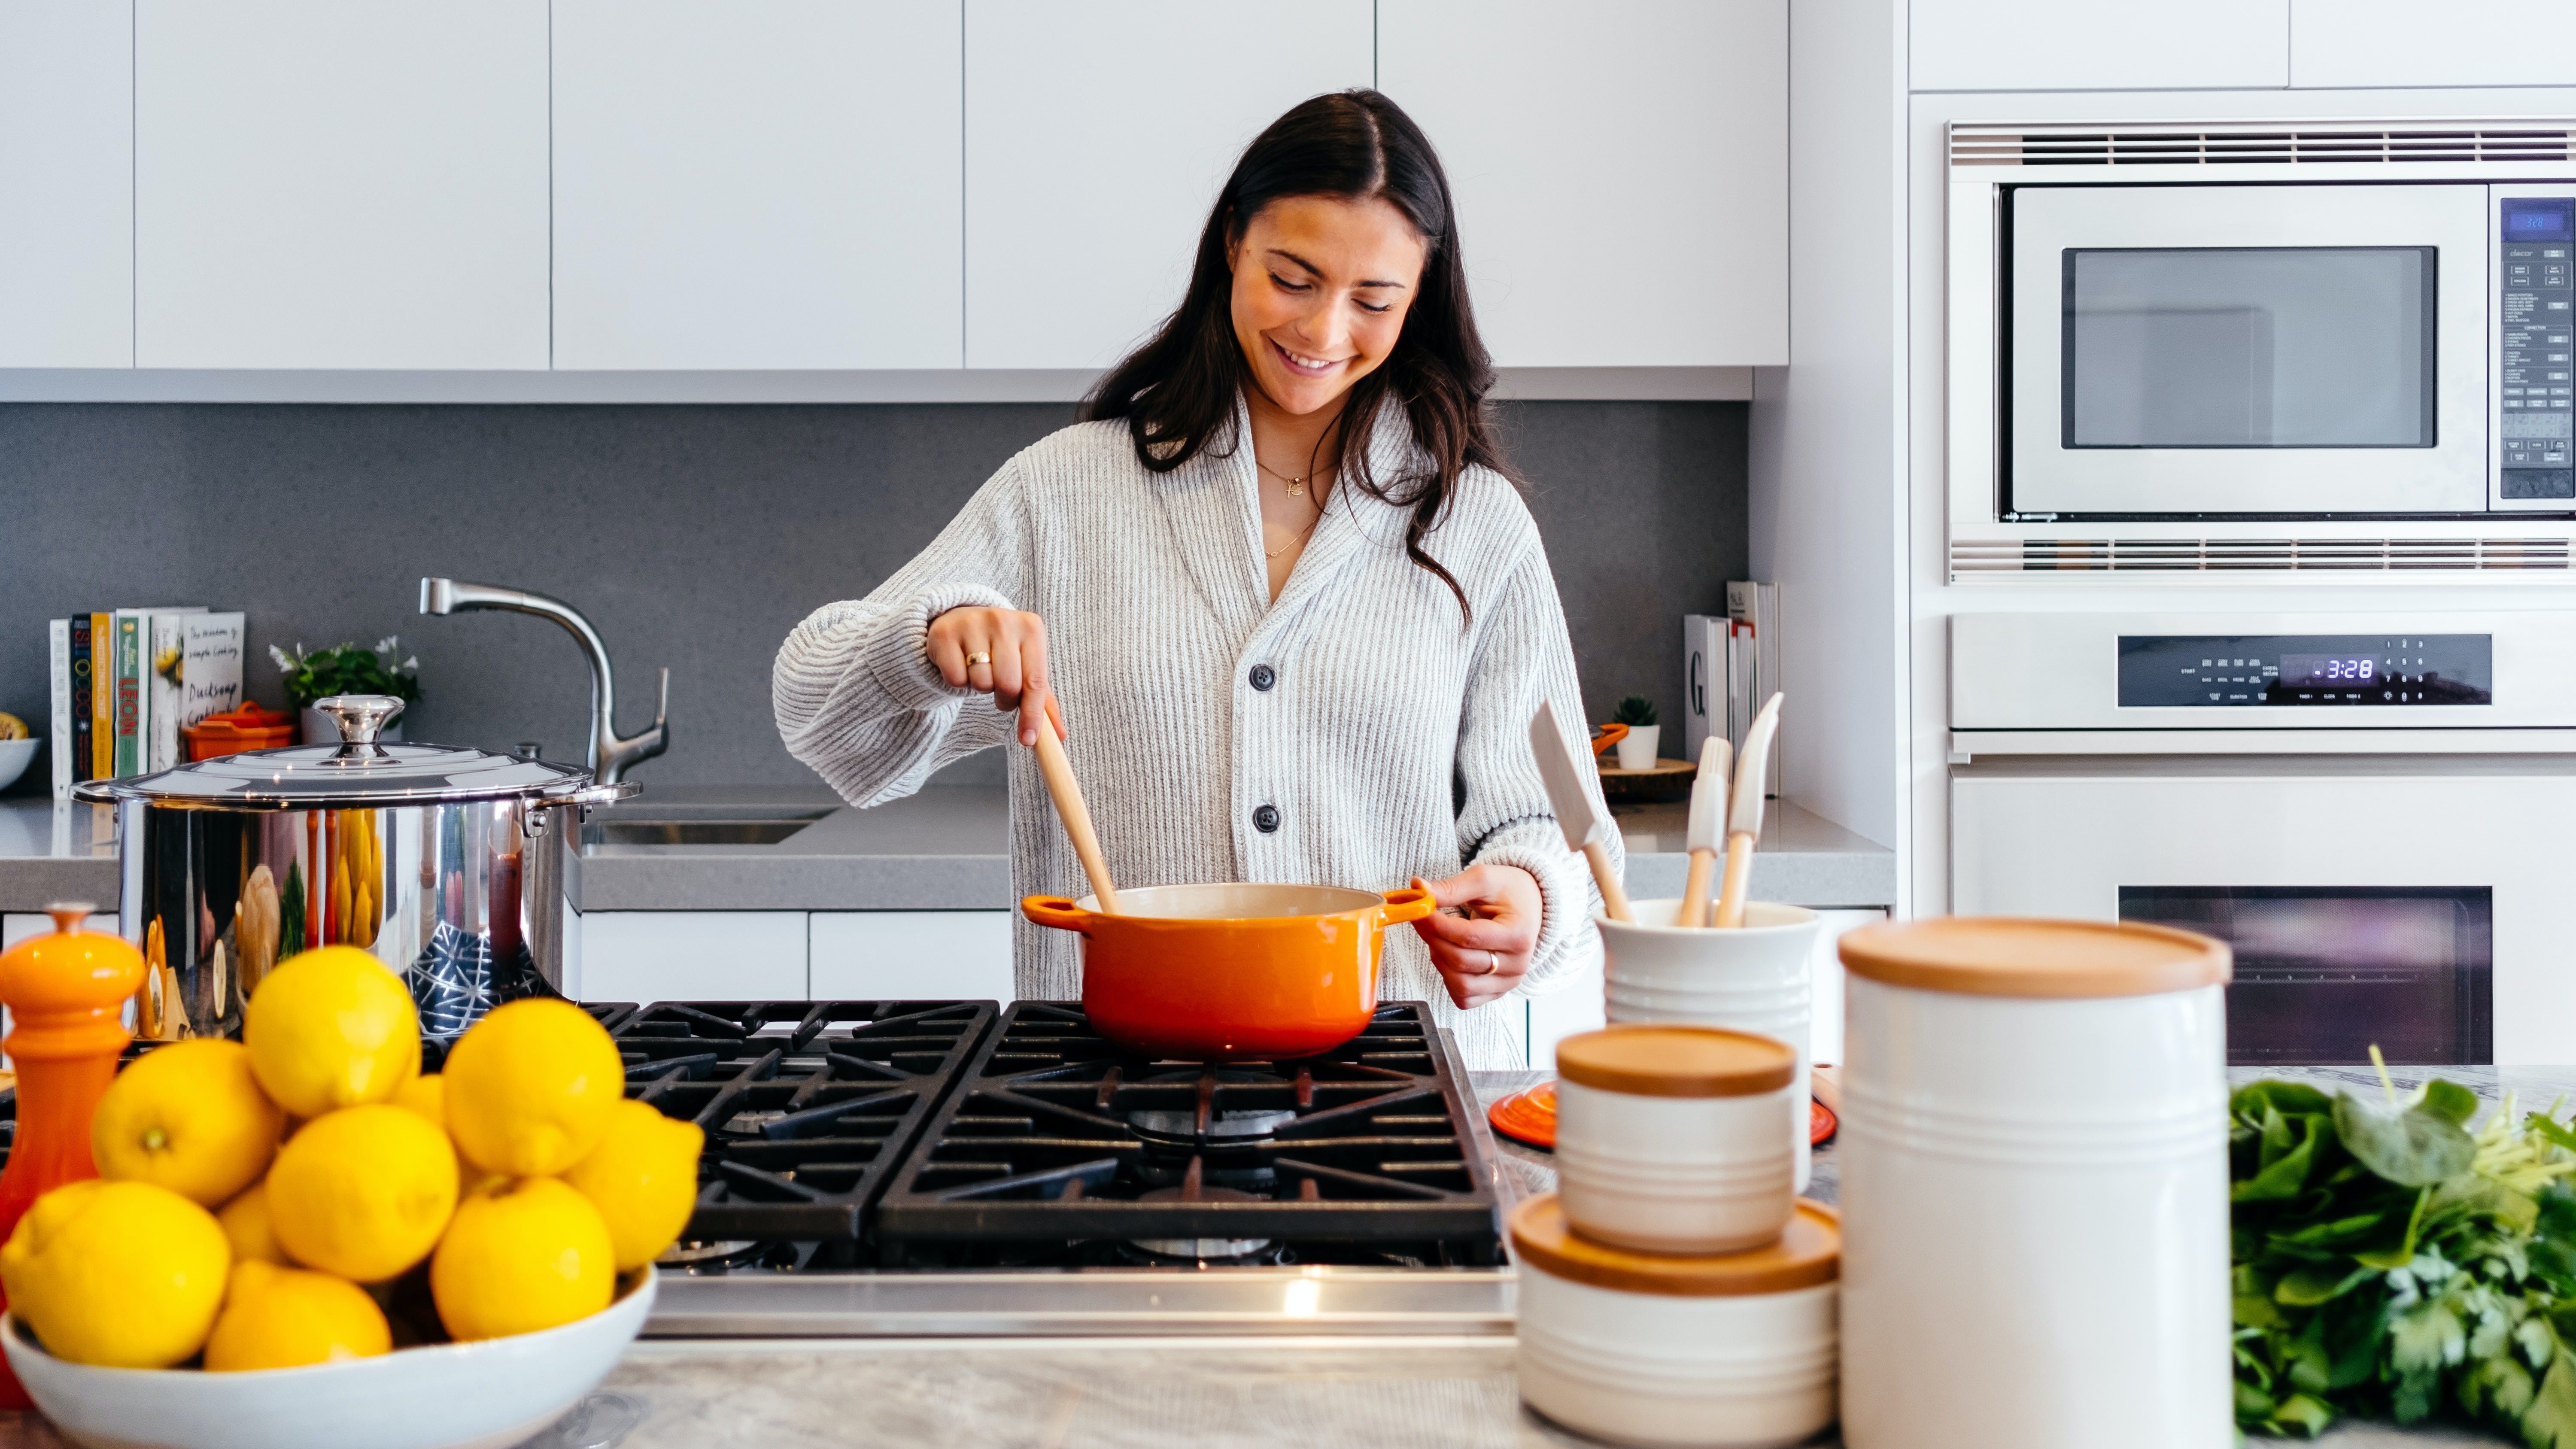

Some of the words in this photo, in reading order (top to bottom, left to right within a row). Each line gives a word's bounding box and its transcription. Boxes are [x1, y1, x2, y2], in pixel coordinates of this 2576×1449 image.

[2327, 659, 2373, 678] 3:28
[189, 681, 237, 703] Ducksoup
[1691, 650, 1705, 717] G
[119, 677, 138, 735] LEON
[188, 704, 232, 727] Cookbk
